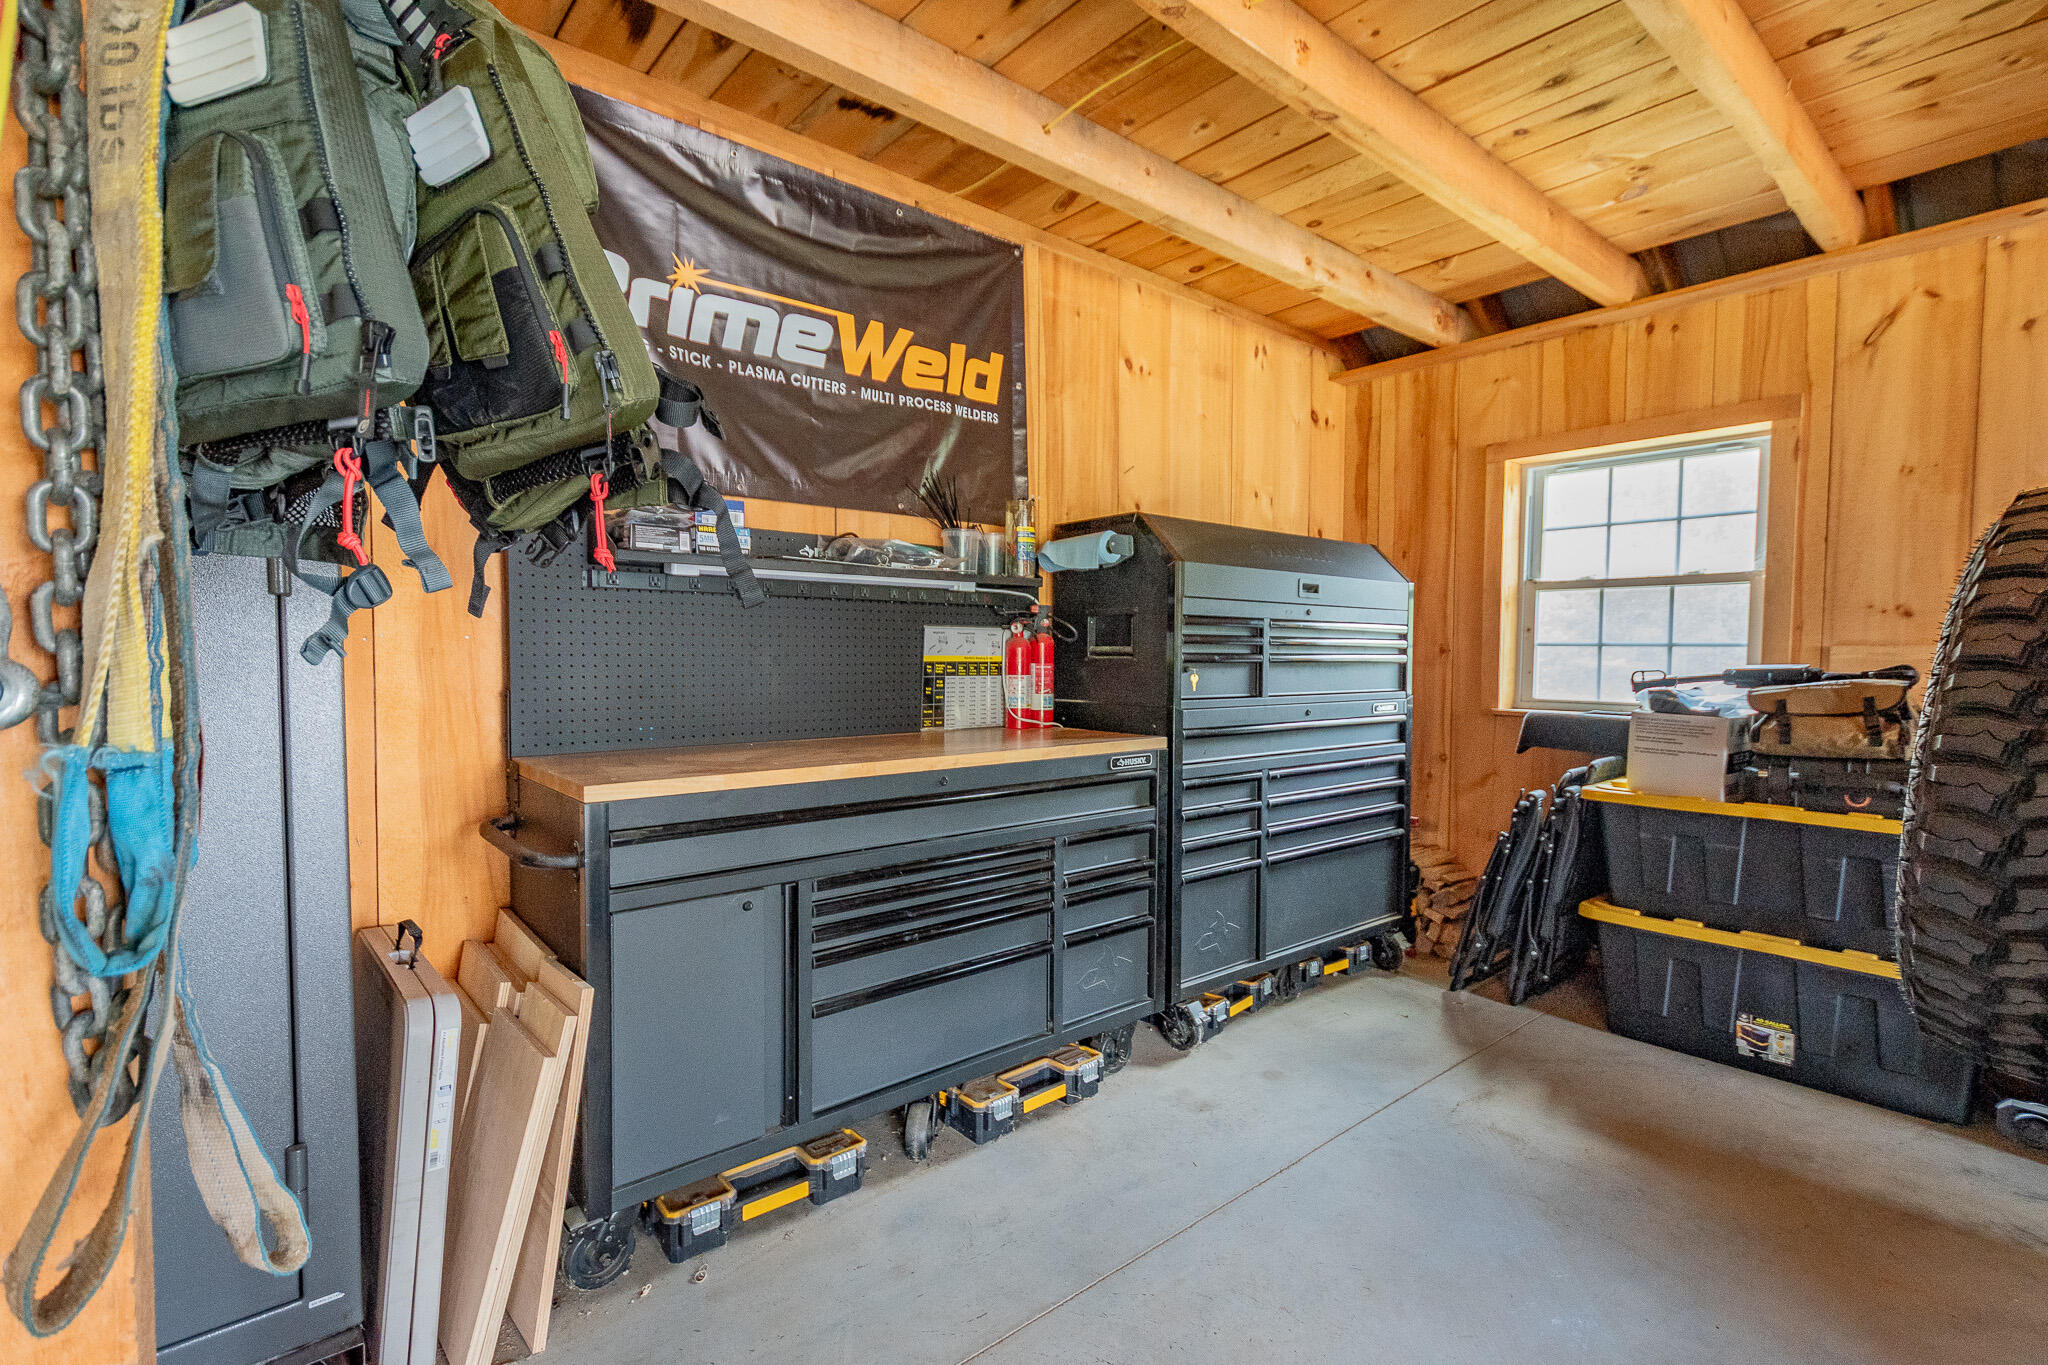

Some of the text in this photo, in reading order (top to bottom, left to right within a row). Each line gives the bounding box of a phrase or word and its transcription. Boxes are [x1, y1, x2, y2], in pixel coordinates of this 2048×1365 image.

[669, 345, 712, 370] STICK
[728, 359, 787, 385] PLASMA
[790, 373, 847, 395] CUTTERS
[860, 386, 895, 406] MULTI
[898, 394, 952, 415] PROCESS
[954, 403, 999, 425] WELDERS
